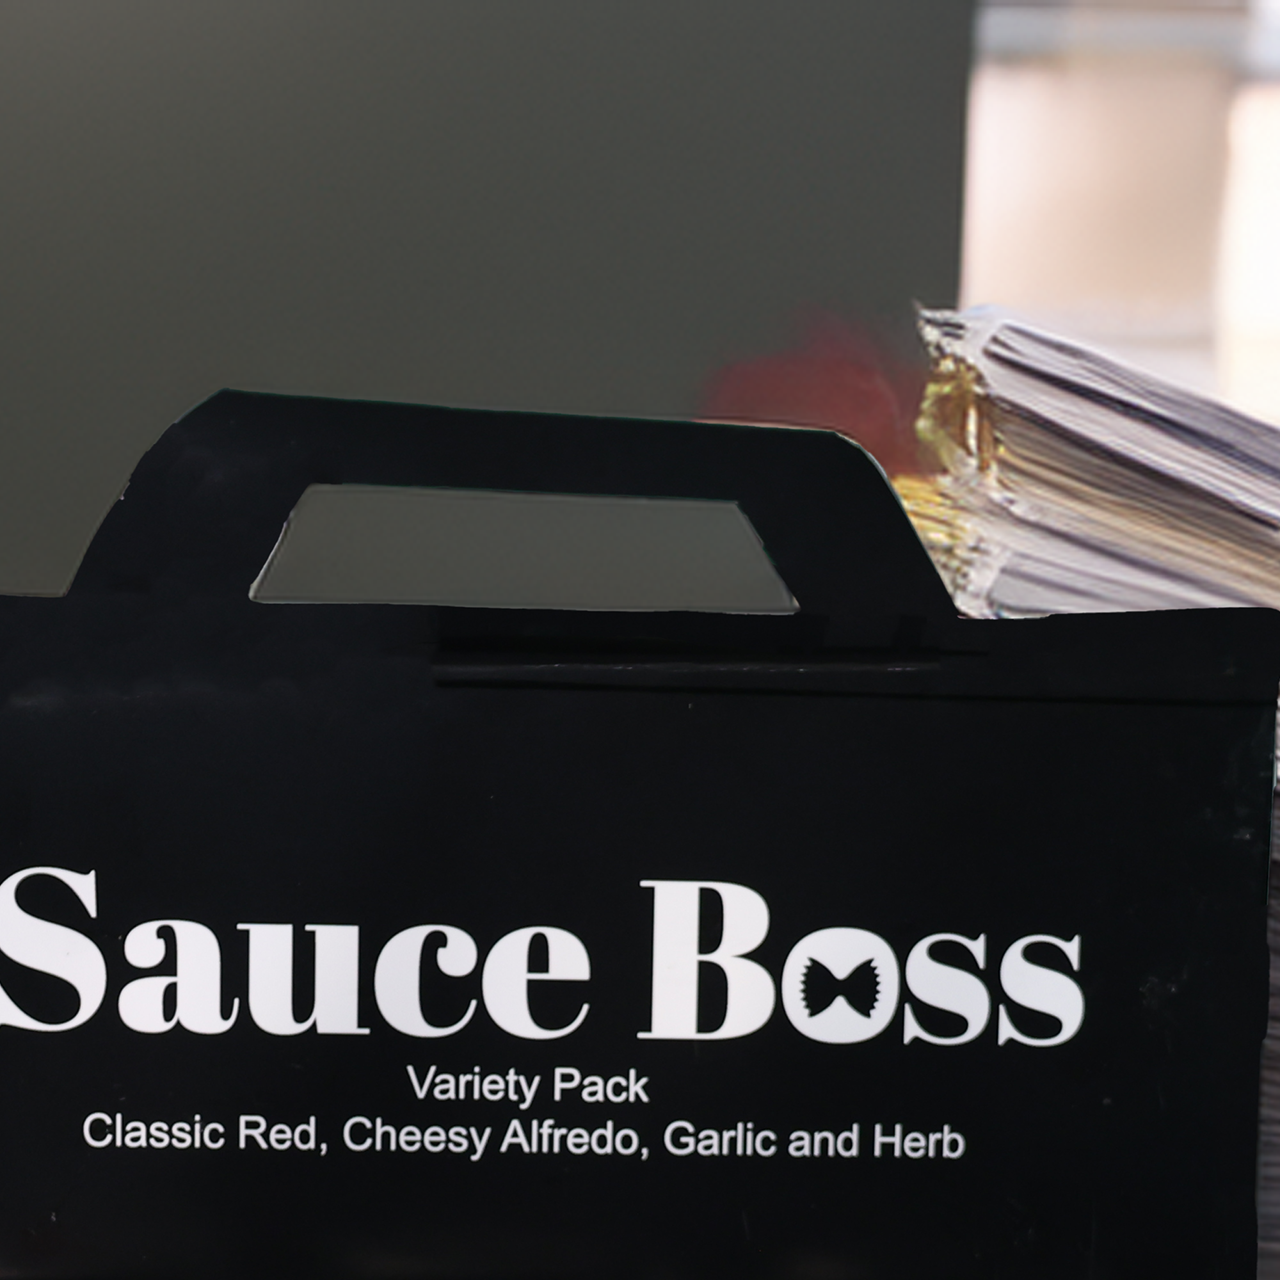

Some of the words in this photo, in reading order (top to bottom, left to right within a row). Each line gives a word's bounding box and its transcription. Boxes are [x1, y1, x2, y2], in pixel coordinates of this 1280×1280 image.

[636, 879, 1085, 1047] Boss
[406, 1064, 541, 1110] Variety
[553, 1066, 650, 1103] Pack
[82, 1111, 226, 1151] Classic
[238, 1114, 328, 1156] Red,
[343, 1115, 492, 1162] Cheesy
[500, 1115, 649, 1161] Alfredo,
[663, 1120, 777, 1157] Garlic
[787, 1122, 860, 1158] and
[873, 1123, 966, 1160] Herb
